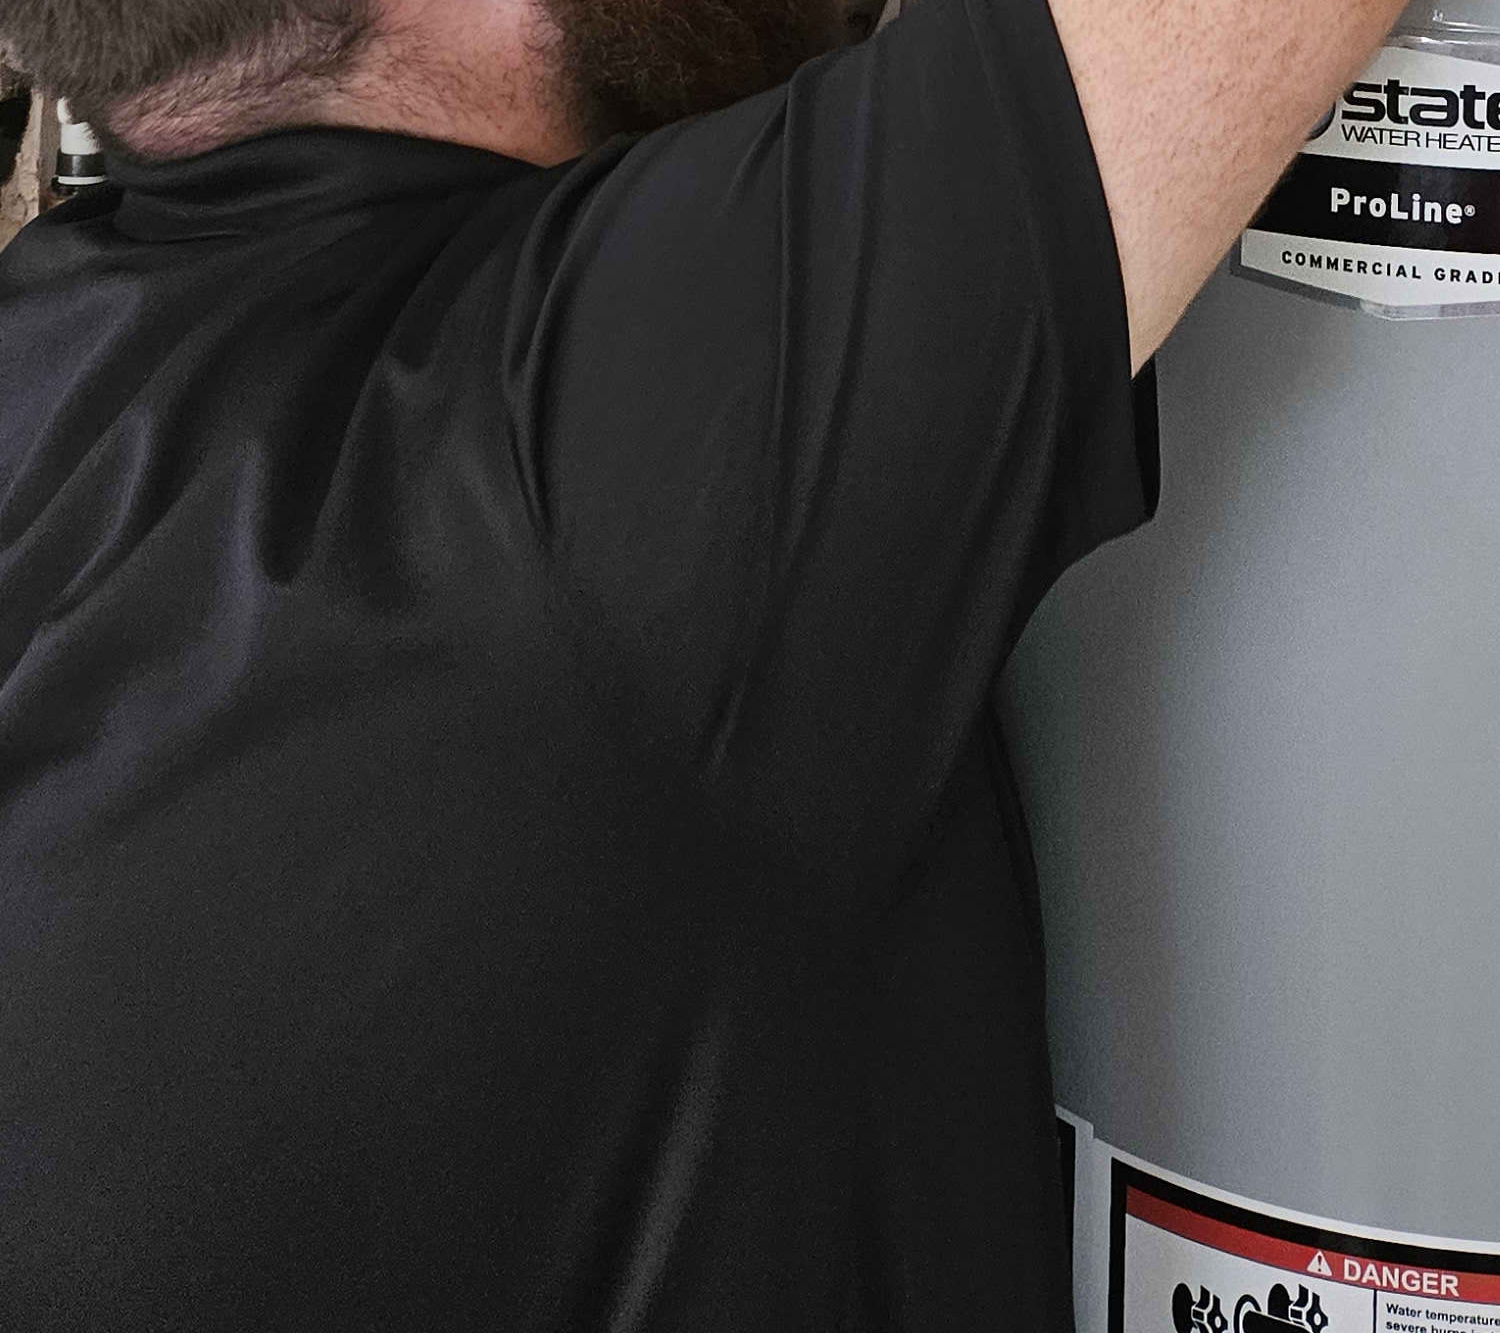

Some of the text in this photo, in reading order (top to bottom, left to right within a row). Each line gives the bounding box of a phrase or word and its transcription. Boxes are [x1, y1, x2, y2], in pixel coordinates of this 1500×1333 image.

[1341, 124, 1422, 149] WATER
[1281, 250, 1421, 281] COMMERCIAL
[1343, 1260, 1459, 1297] DANGER
[1386, 1302, 1422, 1318] Water
[1386, 1321, 1427, 1333] severe
